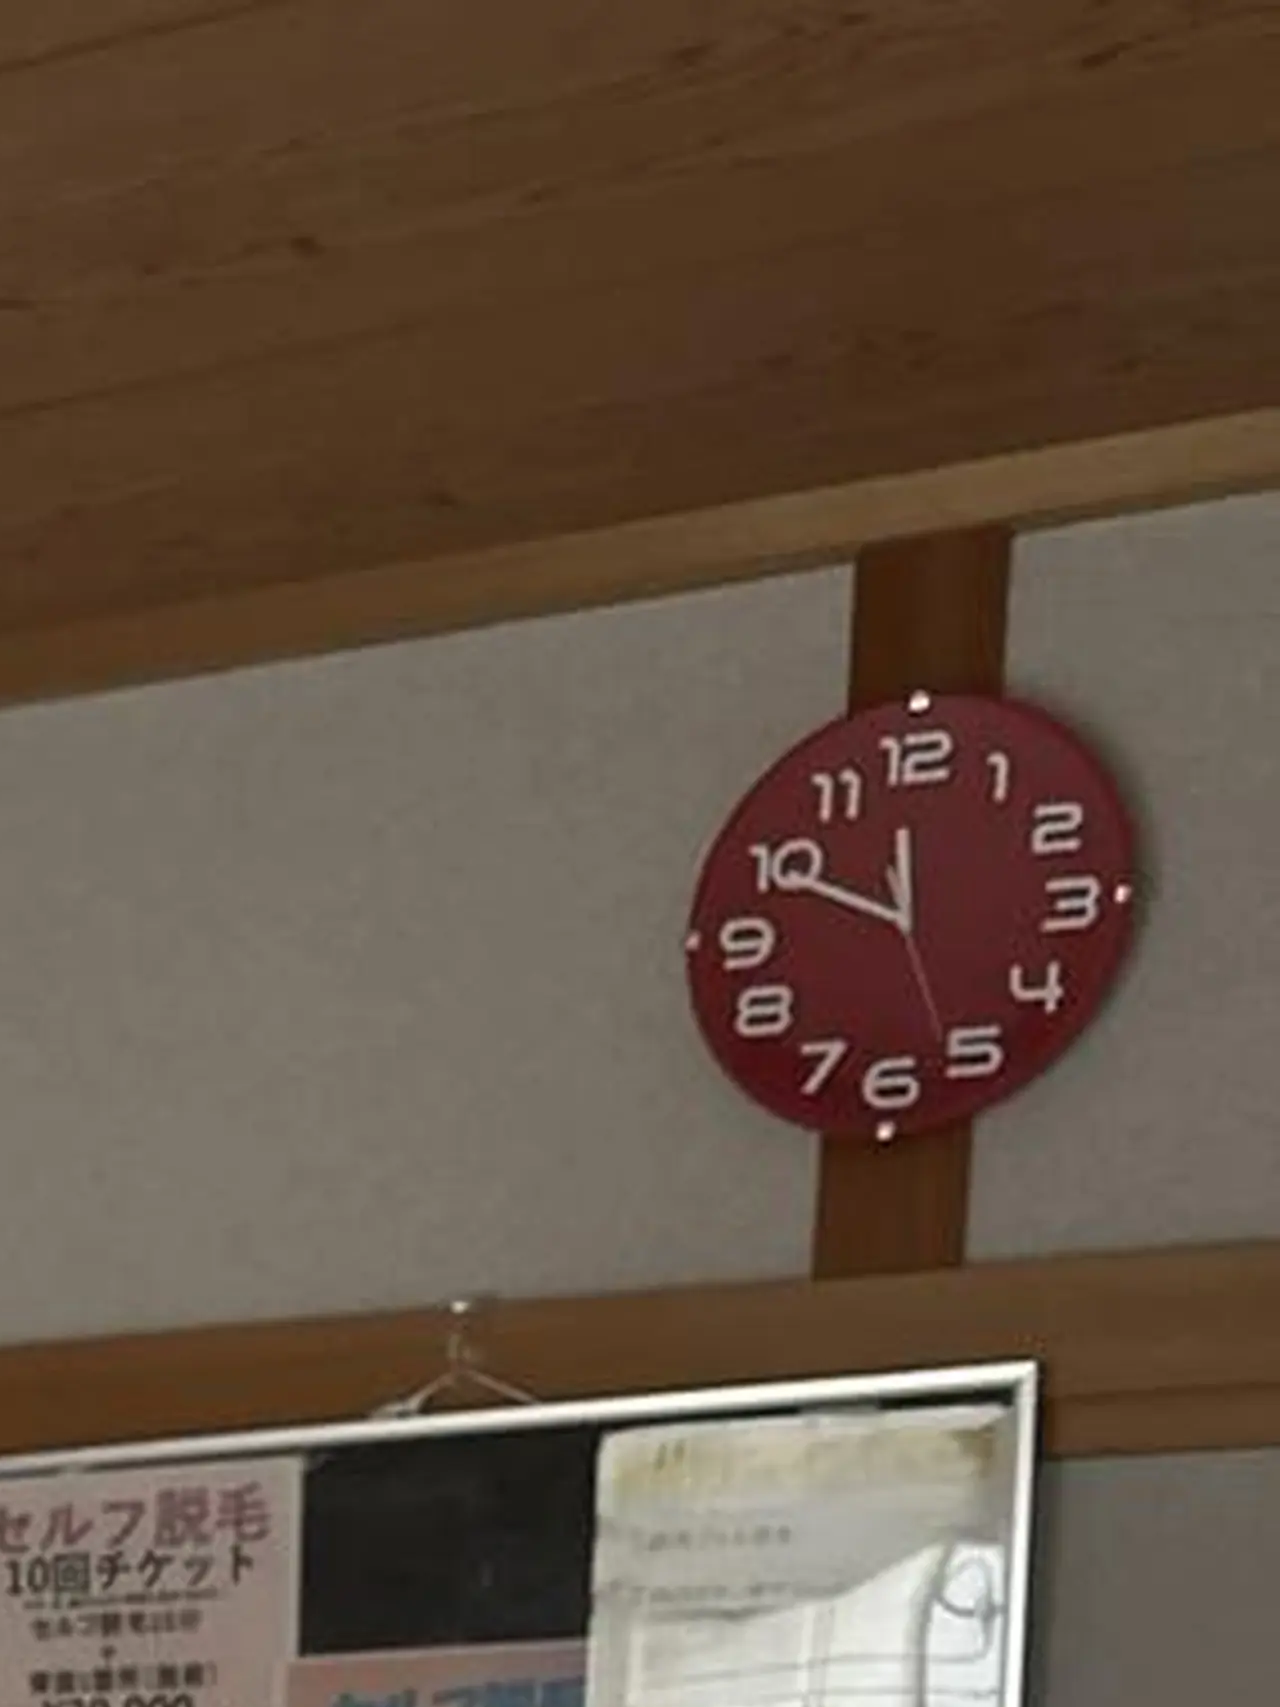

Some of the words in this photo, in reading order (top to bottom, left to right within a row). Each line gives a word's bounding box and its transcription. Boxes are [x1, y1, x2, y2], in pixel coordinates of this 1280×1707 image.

[880, 730, 952, 787] 12
[987, 751, 1009, 802] 1
[813, 769, 860, 823] 11
[1031, 803, 1083, 854] 2
[749, 839, 823, 893] 10
[1041, 876, 1101, 931] 3
[719, 918, 775, 970] 9
[734, 985, 793, 1036] 8
[1010, 961, 1063, 1012] 4
[801, 1040, 848, 1094] 7
[946, 1025, 1003, 1078] 5
[862, 1057, 920, 1109] 6
[5, 1545, 253, 1597] 10回チケット
